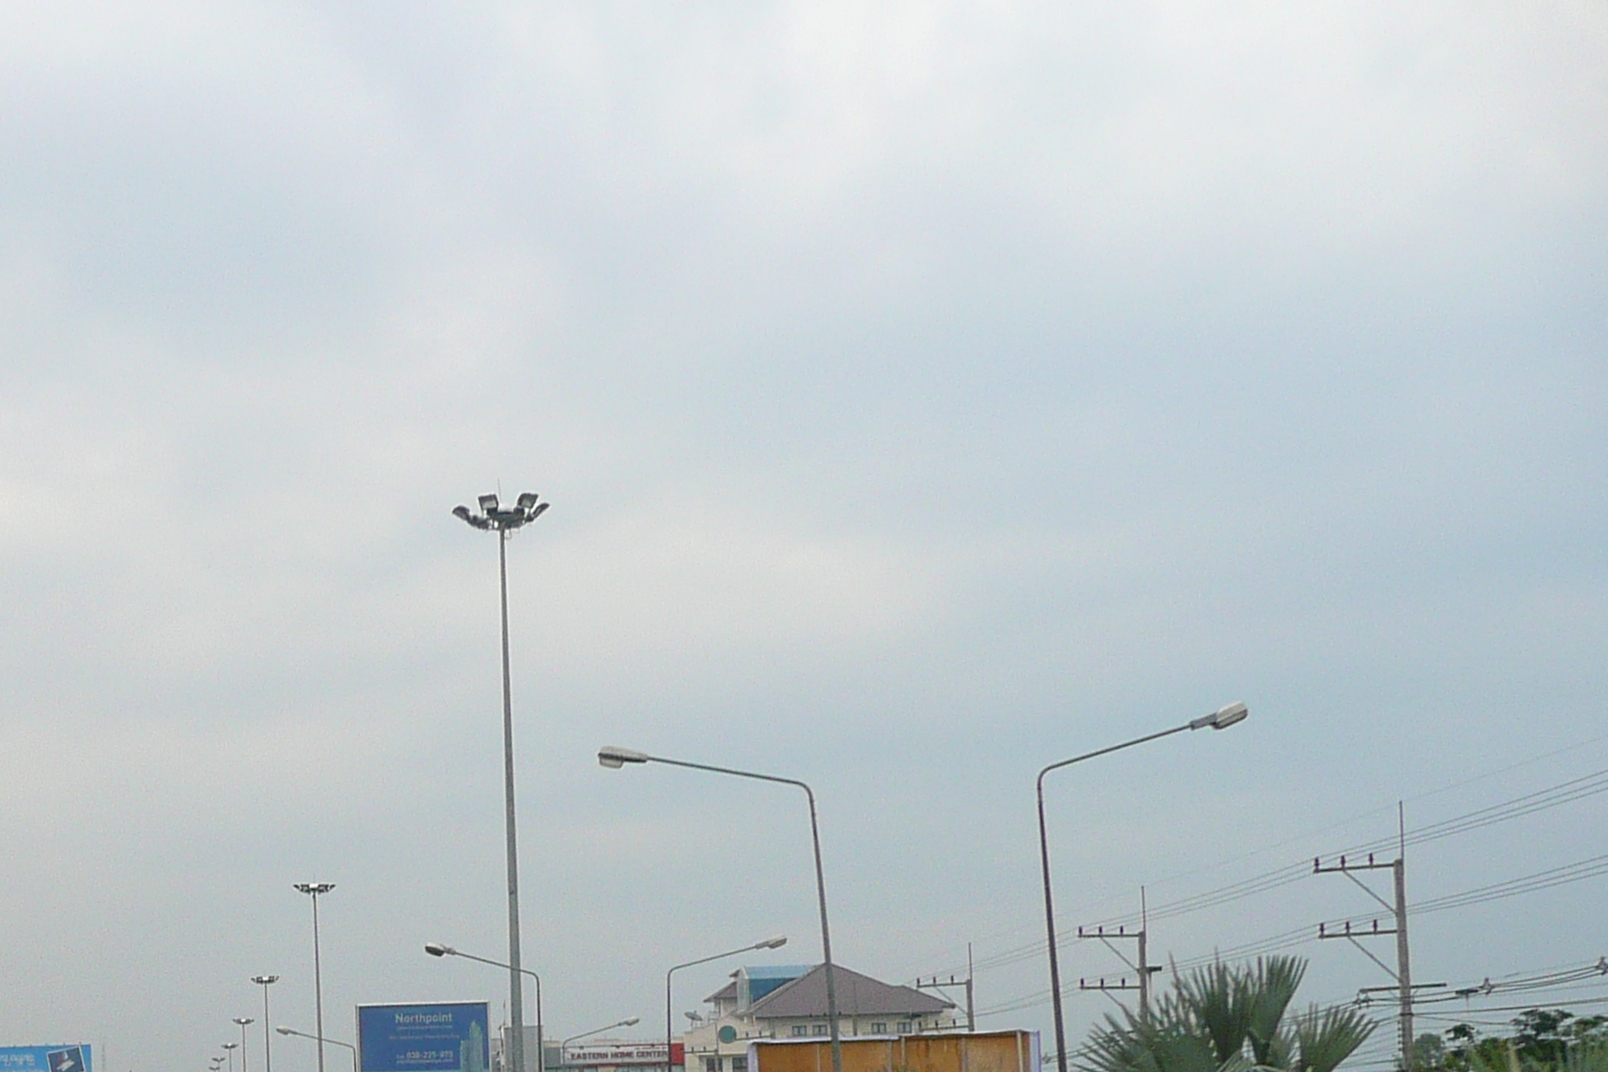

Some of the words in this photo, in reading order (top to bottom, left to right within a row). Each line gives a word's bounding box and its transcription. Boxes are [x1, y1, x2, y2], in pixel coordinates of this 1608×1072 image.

[395, 1012, 453, 1024] Northpoint
[570, 1051, 608, 1061] EASTERN
[610, 1050, 633, 1059] HOME
